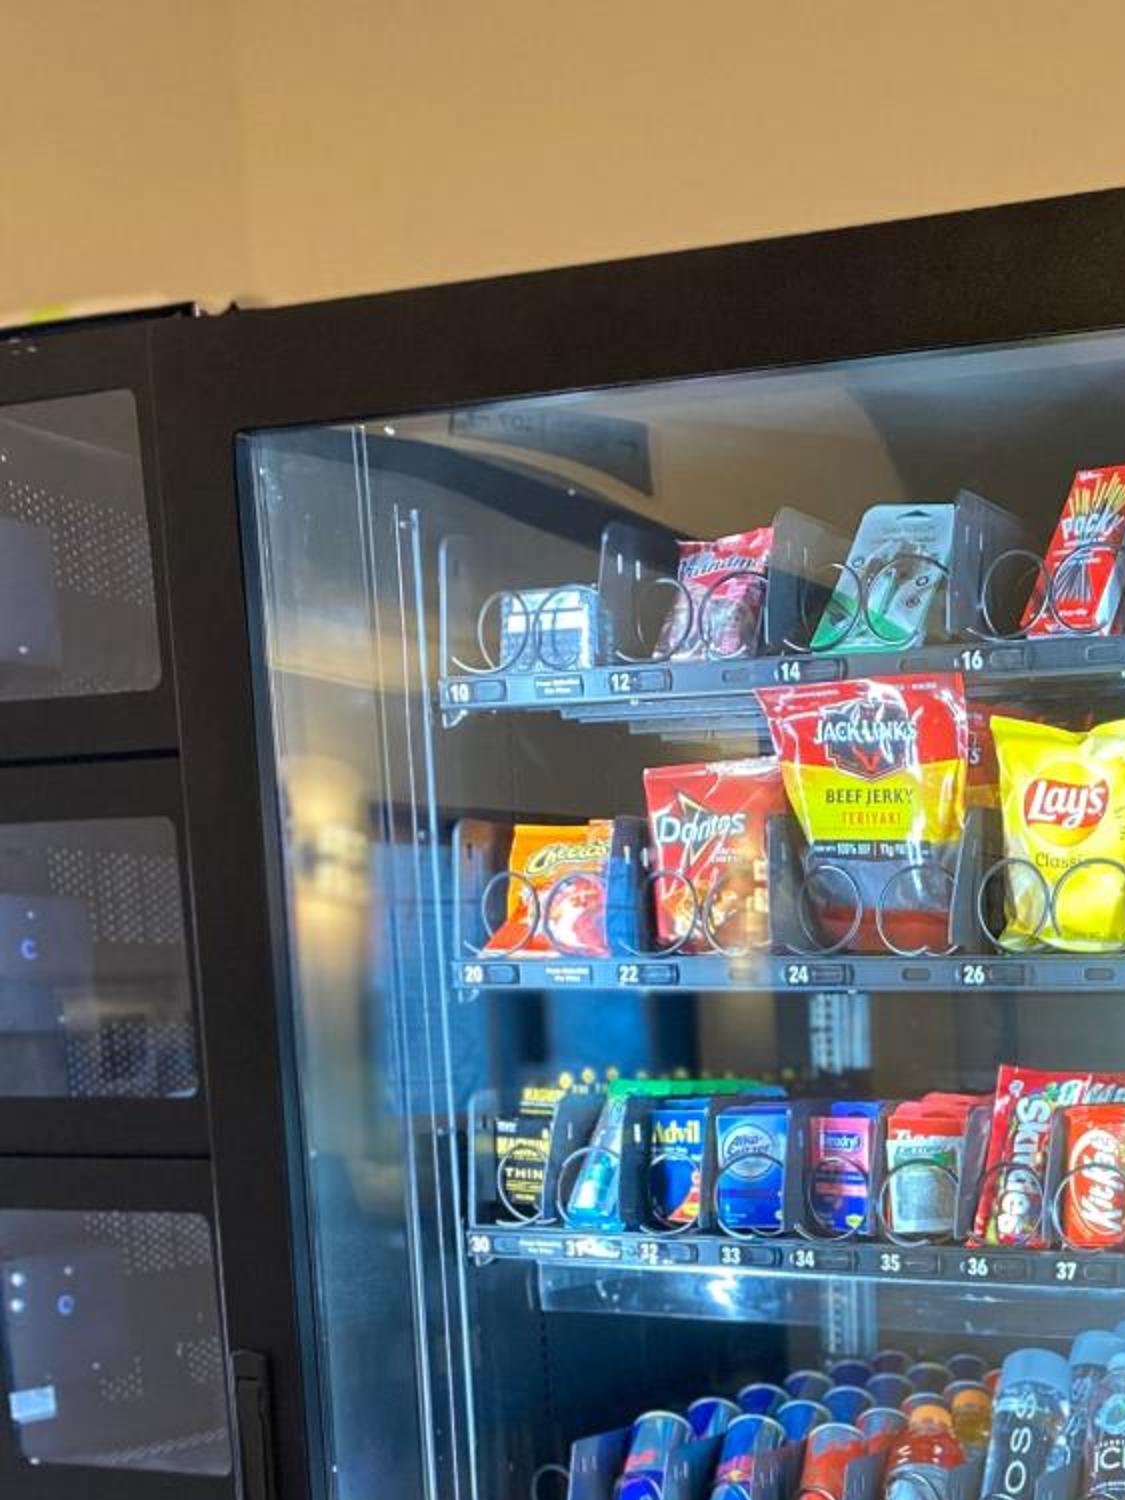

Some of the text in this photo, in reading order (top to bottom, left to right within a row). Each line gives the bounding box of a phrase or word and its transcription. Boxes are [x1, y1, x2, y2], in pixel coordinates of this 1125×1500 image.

[962, 651, 984, 670] 16
[780, 662, 800, 681] 14
[611, 674, 630, 692] 12
[451, 684, 470, 702] 10
[825, 788, 913, 807] BEEF JERKY
[1027, 780, 1107, 829] Lay's
[842, 811, 902, 825] TERIYAKI
[660, 814, 747, 843] Doritos
[465, 967, 483, 983] 20
[619, 965, 639, 983] 22
[789, 965, 808, 984] 24
[963, 966, 985, 985] 26
[651, 1120, 701, 1143] Advil
[505, 1168, 543, 1181] THIN
[722, 1247, 741, 1264] 33
[796, 1250, 815, 1267] 34
[881, 1254, 900, 1271] 35
[967, 1258, 988, 1276] 36
[1056, 1262, 1077, 1281] 37
